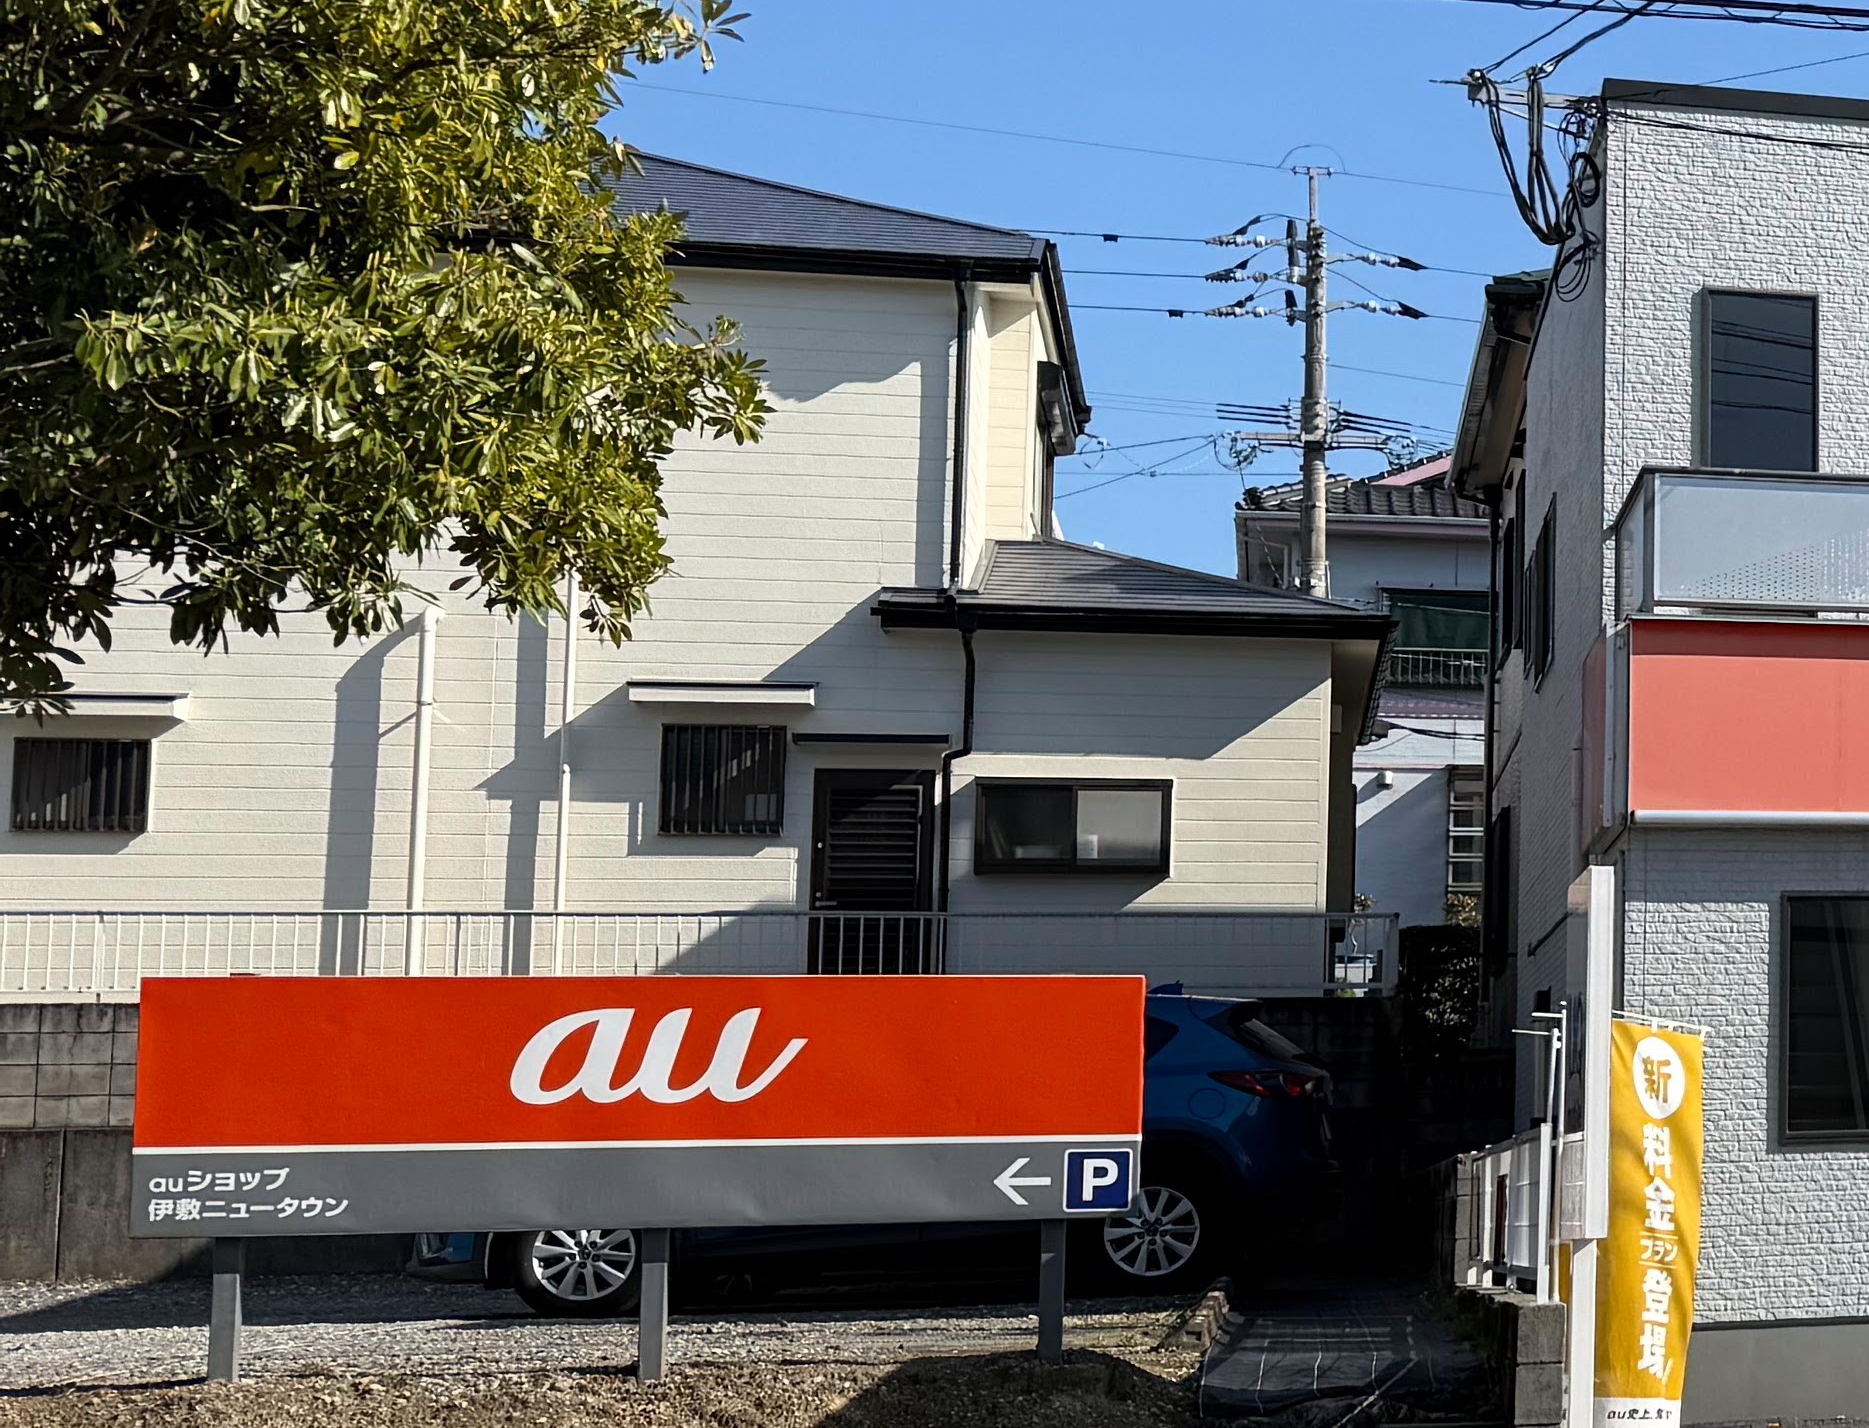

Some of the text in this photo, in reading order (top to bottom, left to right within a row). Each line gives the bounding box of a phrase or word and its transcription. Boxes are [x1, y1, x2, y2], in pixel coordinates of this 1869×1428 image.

[509, 1006, 809, 1105] au
[148, 1166, 290, 1195] auショップ
[1081, 1158, 1121, 1201] P
[148, 1195, 348, 1222] 伊敷ニュータウン
